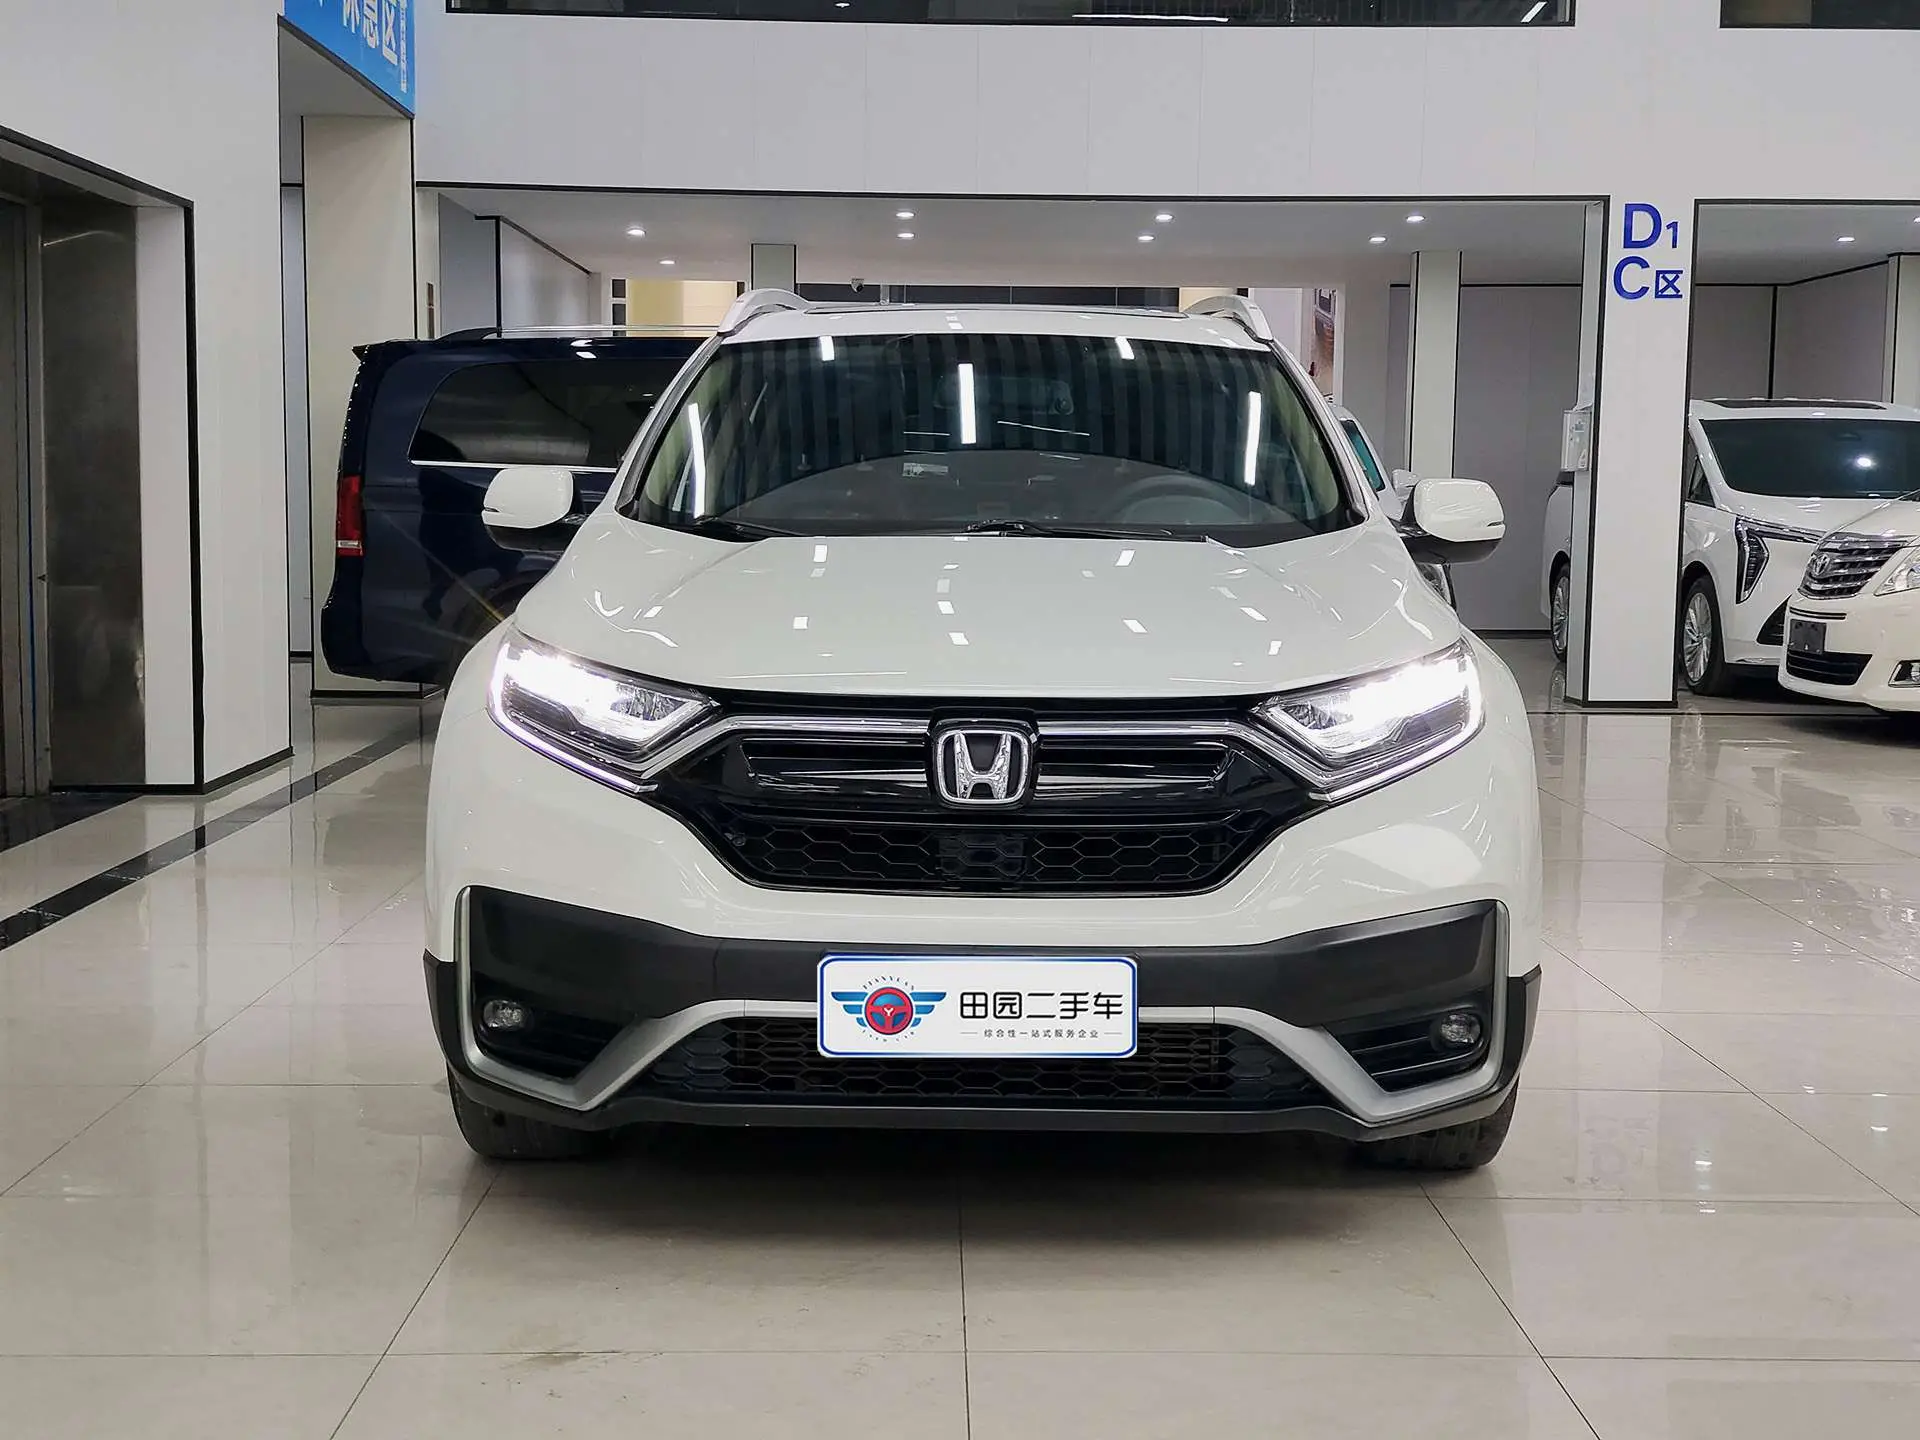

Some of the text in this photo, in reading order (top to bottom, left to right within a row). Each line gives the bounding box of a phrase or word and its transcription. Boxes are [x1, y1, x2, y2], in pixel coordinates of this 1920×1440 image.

[1622, 203, 1679, 249] D1
[1613, 256, 1683, 300] C区
[960, 992, 1123, 1019] 田园二手车
[984, 1029, 1099, 1038] 综合性一站式服务企业
